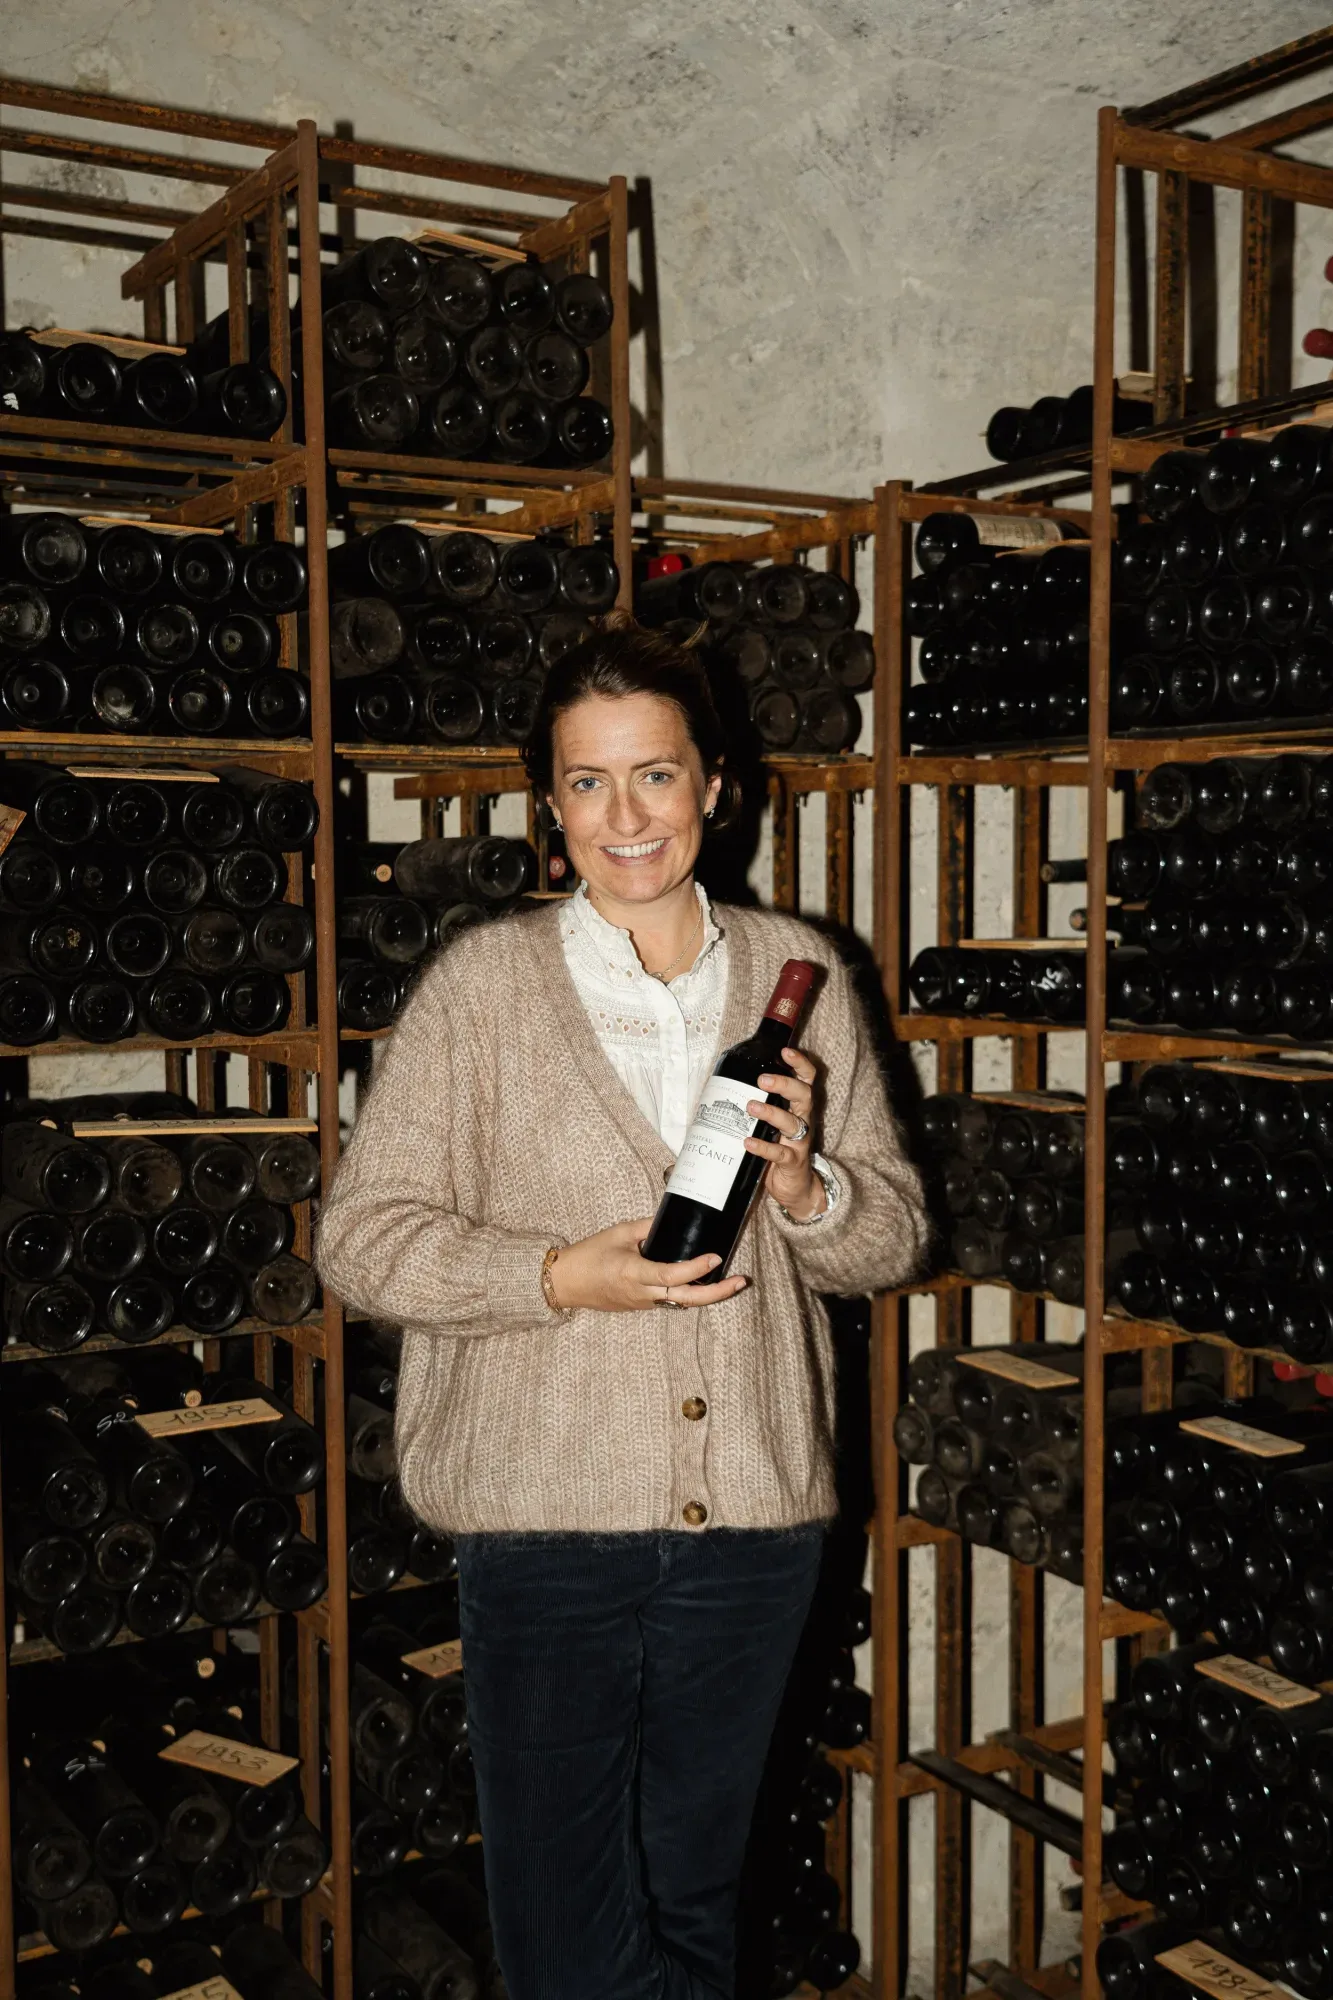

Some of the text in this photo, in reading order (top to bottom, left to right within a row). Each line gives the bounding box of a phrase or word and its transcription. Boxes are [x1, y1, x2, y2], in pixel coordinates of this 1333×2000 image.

[165, 1404, 256, 1425] 1952
[187, 1743, 268, 1769] 1953
[1188, 1957, 1273, 2000] 1981
